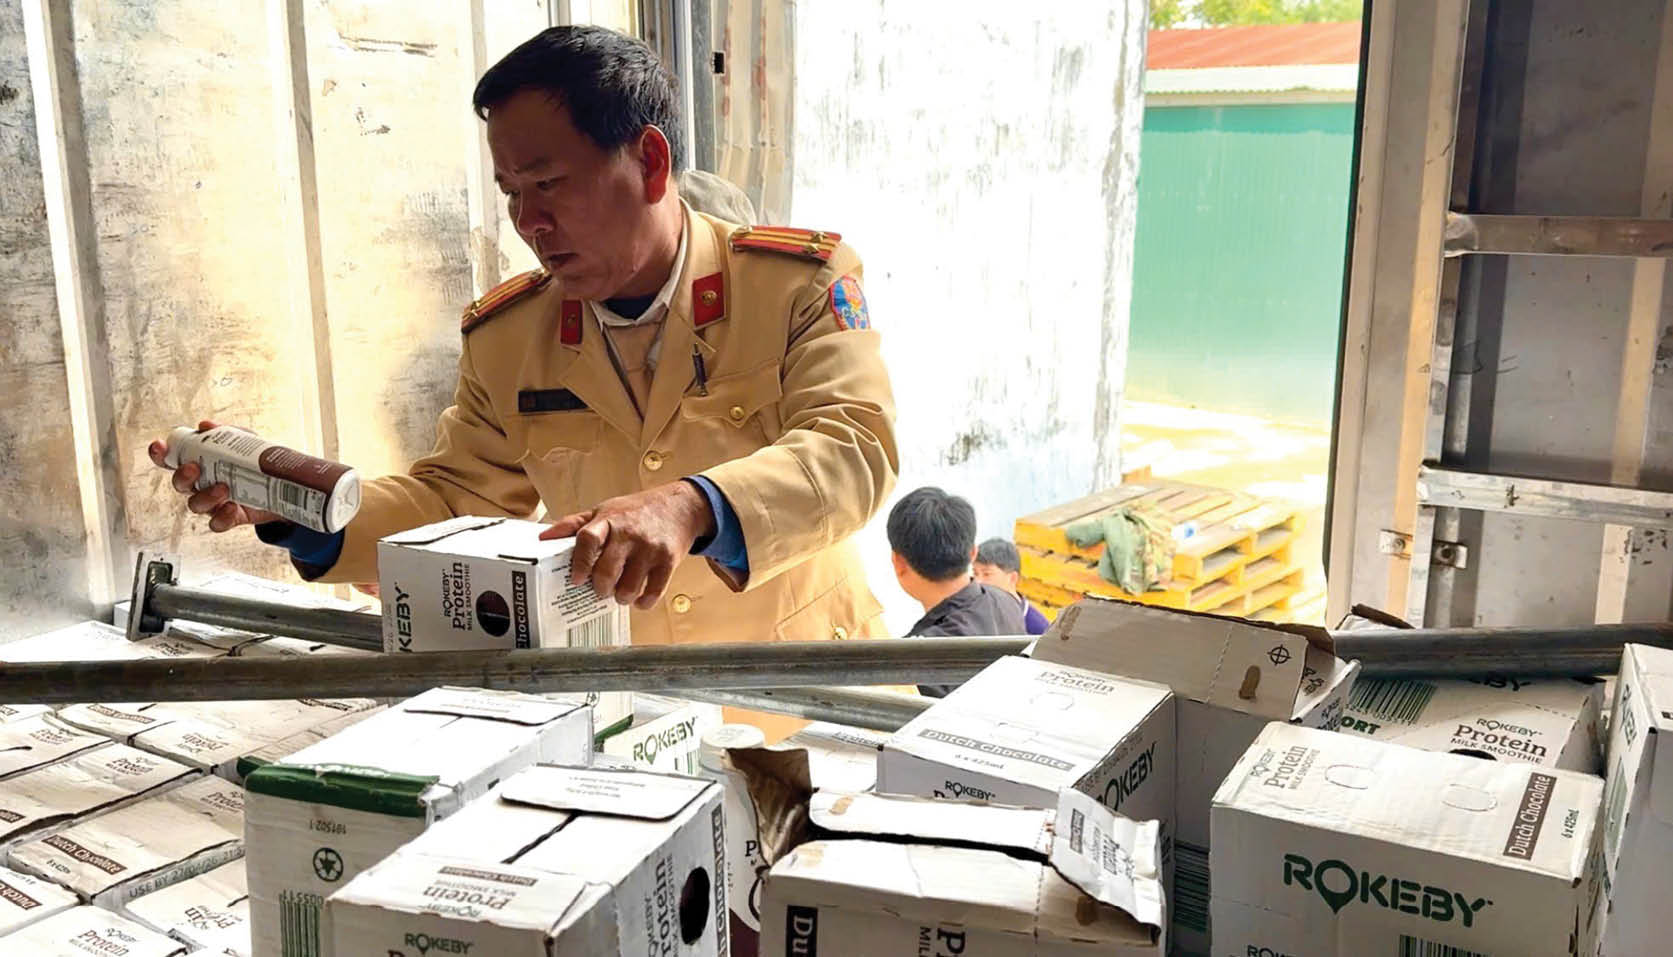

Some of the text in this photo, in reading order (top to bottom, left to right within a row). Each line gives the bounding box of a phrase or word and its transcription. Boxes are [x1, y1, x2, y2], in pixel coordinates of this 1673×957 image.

[450, 562, 466, 631] Protein
[395, 586, 412, 652] KEBY
[1040, 671, 1114, 692] Protein
[633, 715, 696, 765] ROKEBY
[1341, 716, 1380, 735] ORT
[1453, 724, 1547, 757] Protein
[1476, 718, 1538, 737] ROKEBY
[926, 730, 1069, 769] Dutch Chocolate
[1450, 738, 1543, 764] MILK SMOOTHIE
[1263, 745, 1308, 789] Protein
[944, 780, 992, 800] ROKEBY
[1508, 776, 1550, 856] Dutch Chocolate
[129, 882, 152, 898] USE
[154, 875, 168, 889] BY
[713, 810, 726, 932] Chocolate
[423, 886, 512, 910] Protein
[1283, 853, 1487, 928] ROKEBY
[654, 858, 671, 957] rotein
[78, 930, 129, 957] Protein
[405, 932, 473, 955] ROKEBY
[919, 926, 931, 957] MIL
